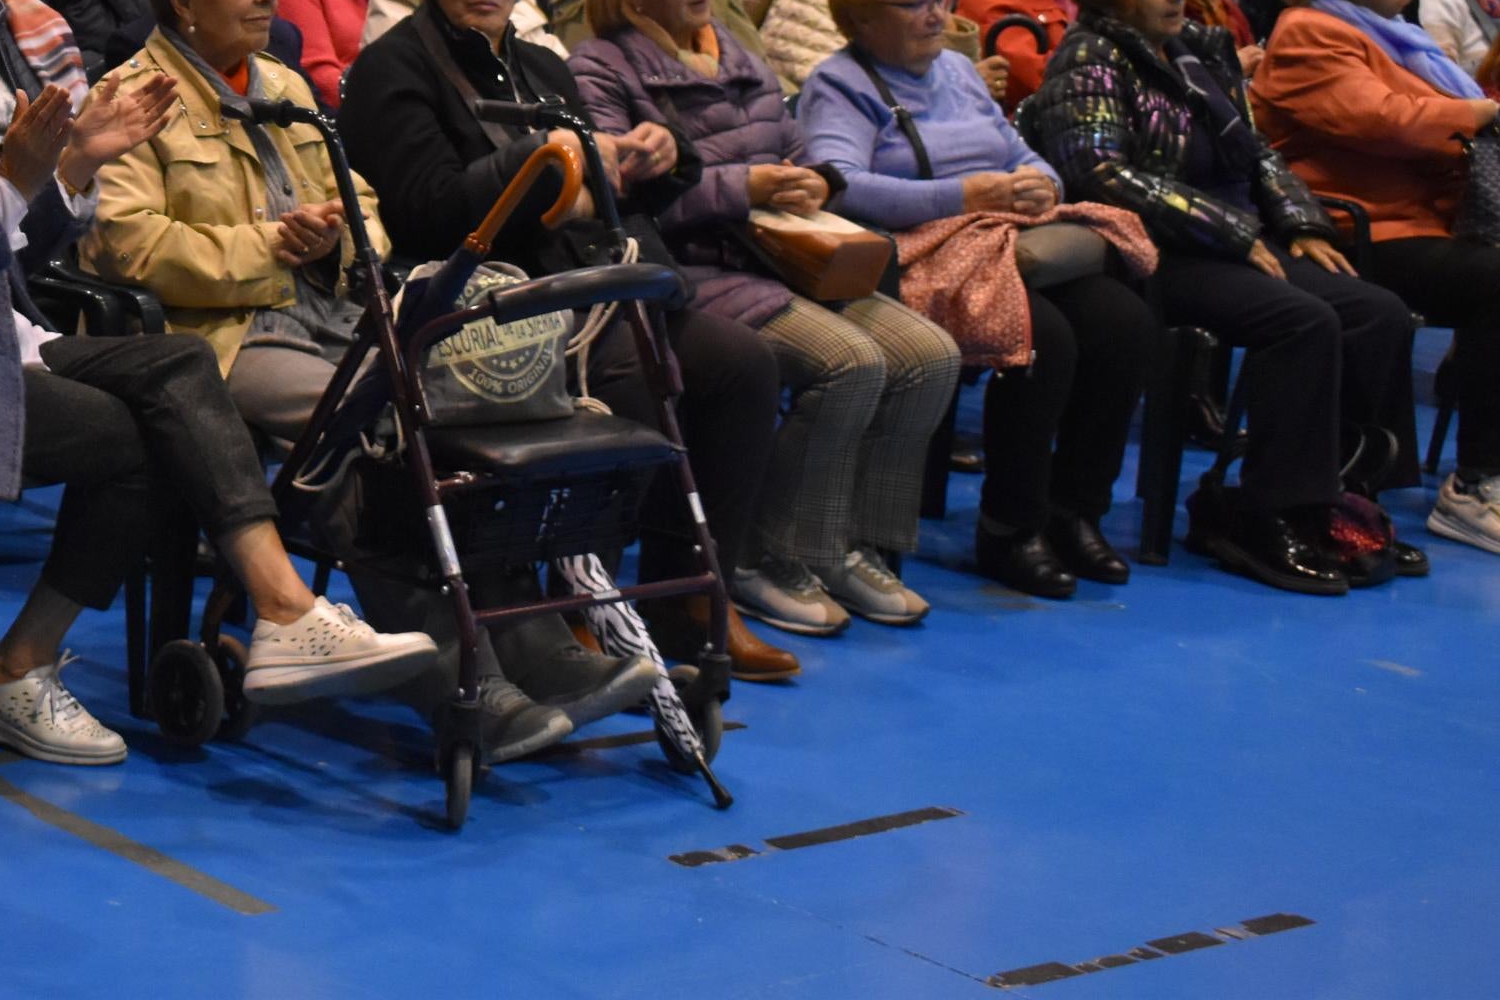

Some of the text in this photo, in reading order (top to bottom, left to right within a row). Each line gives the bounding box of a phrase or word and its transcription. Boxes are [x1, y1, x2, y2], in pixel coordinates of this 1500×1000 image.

[437, 322, 504, 357] ESCURIAL
[467, 348, 552, 394] 100% ORIGINAL
